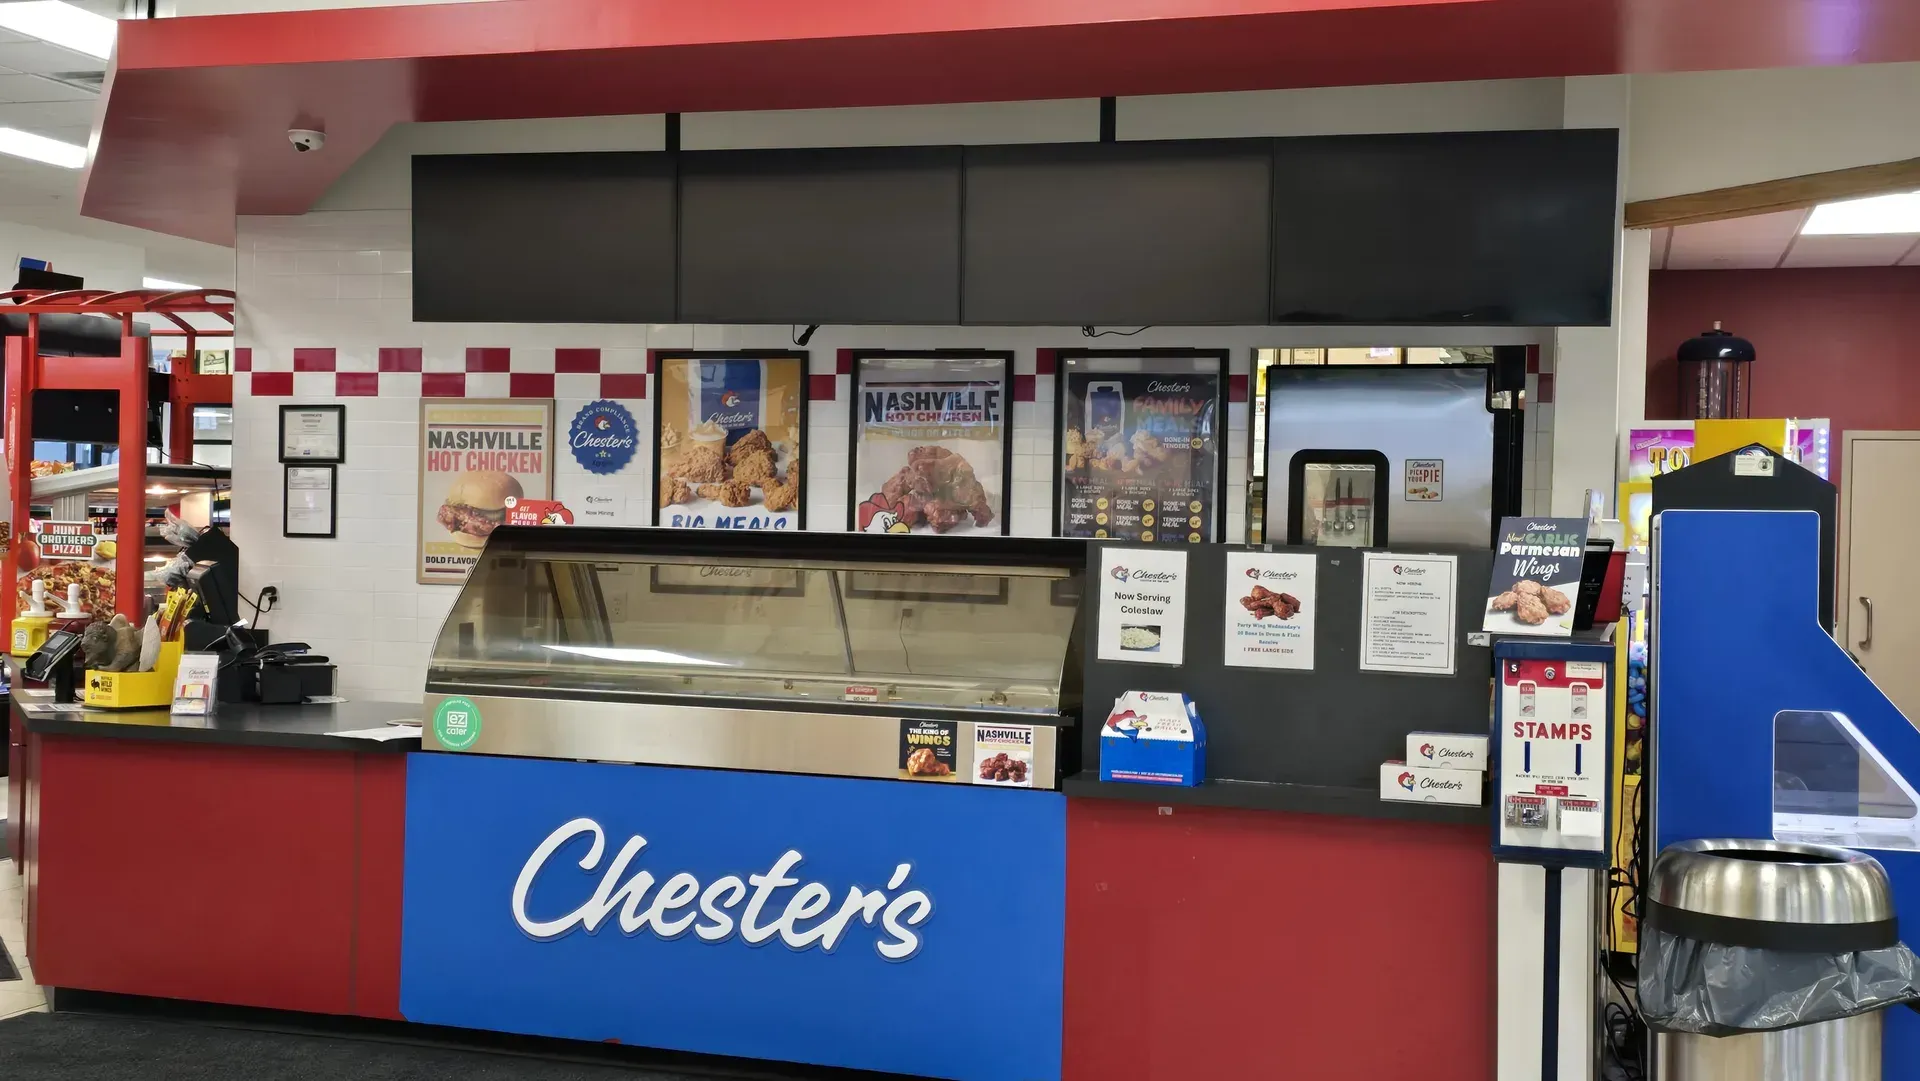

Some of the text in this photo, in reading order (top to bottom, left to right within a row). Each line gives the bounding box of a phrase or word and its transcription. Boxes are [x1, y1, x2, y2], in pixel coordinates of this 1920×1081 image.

[1147, 381, 1190, 392] Chester's
[865, 390, 999, 422] NASHVILLE
[1133, 396, 1205, 415] FAMILY
[576, 410, 593, 430] BRAND
[596, 406, 630, 433] COMPLIANCE
[885, 412, 982, 422] HOT CHICKEN
[428, 430, 542, 450] NASHVILLE
[574, 431, 632, 448] Chester's
[428, 451, 542, 474] HOT CHICKEN
[1424, 470, 1440, 482] PIE
[512, 512, 538, 520] FLAVOR
[672, 514, 704, 528] BIG
[52, 526, 82, 535] HUNT
[1526, 522, 1556, 531] Chester's
[42, 534, 94, 546] BROTHERS
[1525, 533, 1578, 545] GARLIC
[52, 545, 82, 554] PIZZA
[1500, 542, 1580, 558] Parmesan
[426, 556, 446, 564] BOLD
[1132, 570, 1178, 580] Chester's
[1262, 570, 1298, 578] Chester's
[1512, 557, 1560, 582] Wings
[1114, 592, 1171, 604] Now Serving
[1120, 606, 1164, 616] Coleslaw
[450, 714, 465, 725] ez
[977, 730, 1031, 744] NASHVILLE
[1514, 722, 1592, 740] STAMPS
[906, 734, 950, 746] WINGS
[1438, 748, 1474, 758] Chester's
[1420, 778, 1462, 790] Chester's
[512, 818, 932, 959] Chester's
